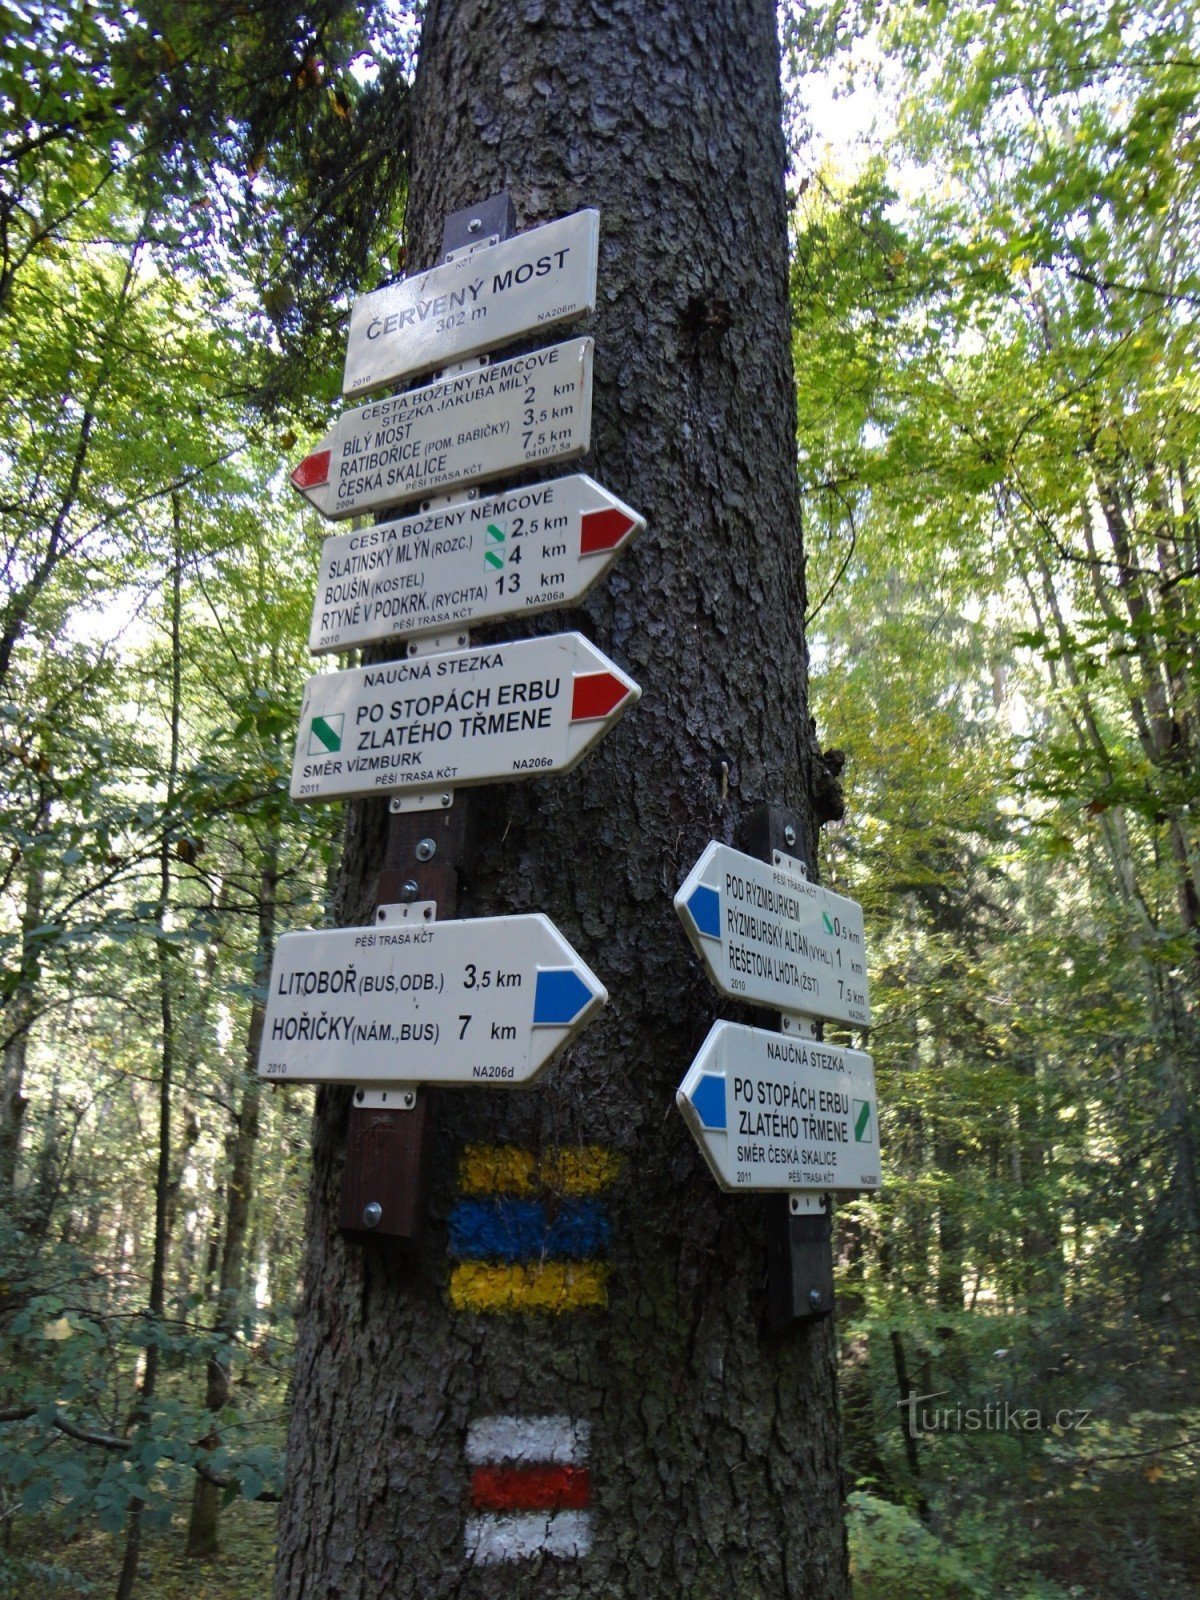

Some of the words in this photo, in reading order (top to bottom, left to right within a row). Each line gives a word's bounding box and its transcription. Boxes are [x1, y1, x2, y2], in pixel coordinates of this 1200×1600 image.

[366, 278, 484, 340] ČERVENÝ
[492, 248, 571, 293] MOST
[435, 311, 467, 334] 302
[471, 307, 488, 321] m
[537, 303, 577, 322] NA206m
[352, 375, 371, 388] 2010
[362, 397, 408, 420] CESTA
[412, 377, 472, 408] BOŽENY
[478, 349, 560, 384] NĚMCOVÉ
[342, 431, 371, 457] BÍLÝ
[375, 423, 414, 448] MOST
[523, 386, 536, 405] 2
[553, 382, 576, 397] km
[381, 405, 434, 428] STEZKA
[436, 386, 495, 413] JAKUBA
[340, 440, 422, 478] RATIBOŘICE
[457, 420, 510, 445] BABIČKY)
[522, 408, 548, 427] 3,5
[551, 405, 574, 420] km
[337, 471, 383, 499] ČESKÁ
[386, 455, 448, 488] SKALICE
[521, 430, 545, 450] 7,5
[550, 427, 572, 443] km
[405, 479, 427, 492] PĚŠÍ
[428, 470, 461, 487] TRASA
[463, 463, 484, 478] KČT
[336, 499, 355, 510] 2004
[349, 528, 397, 551] CESTA
[402, 512, 466, 538] BOŽENY
[470, 489, 554, 522] NĚMCOVÉ
[511, 517, 539, 540] 2,5
[544, 514, 568, 530] km
[508, 544, 522, 565] 4
[541, 544, 567, 559] km
[320, 603, 360, 631] RTYNĚ
[363, 602, 373, 622] V
[495, 573, 521, 596] 13
[540, 571, 565, 588] km
[525, 591, 565, 605] NA206a
[393, 617, 415, 631] PĚŠÍ
[416, 611, 451, 628] TRASA
[452, 607, 474, 622] KČT
[319, 634, 340, 646] 2010
[363, 661, 432, 688] NAUČNÁ
[437, 653, 504, 677] STEZKA
[355, 702, 384, 726] PO
[389, 687, 491, 721] STOPÁCH
[497, 678, 560, 706] ERBU
[357, 719, 453, 751] ZLATÉHO
[460, 707, 552, 738] TŘMENE
[303, 758, 342, 778] SMĚR
[347, 750, 423, 773] VÍZMBURK
[375, 771, 398, 786] PĚŠÍ
[400, 769, 434, 784] TRASA
[436, 766, 458, 780] KČT
[512, 757, 553, 770] NA206e
[300, 784, 320, 795] 2011
[787, 878, 806, 894] TRASA
[726, 873, 744, 901] POD
[746, 878, 800, 921] RÝZMBURKEM
[833, 916, 848, 940] 0,5
[848, 930, 861, 945] km
[355, 934, 376, 948] PĚŠÍ
[378, 933, 411, 946] TRASA
[413, 931, 435, 944] KČT
[727, 905, 783, 949] RÝZMBURSKÝ
[836, 947, 842, 968] 1
[851, 957, 863, 975] km
[463, 963, 491, 991] 3,5
[496, 970, 522, 988] km
[728, 940, 774, 982] ŘEŠETOVA
[837, 979, 852, 1003] 7,5
[853, 990, 865, 1006] km
[731, 978, 746, 991] 2010
[458, 1014, 472, 1041] 7
[491, 1021, 517, 1041] km
[267, 1062, 287, 1075] 2010
[767, 1042, 808, 1066] NAUČNÁ
[810, 1051, 845, 1073] STEZKA
[472, 1065, 515, 1079] NA206d
[734, 1077, 753, 1103] PO
[757, 1081, 816, 1111] STOPÁCH
[819, 1091, 849, 1115] ERBU
[739, 1109, 799, 1139] ZLATÉHO
[802, 1113, 848, 1143] TŘMENE
[737, 1143, 765, 1163] SMĚR
[768, 1144, 799, 1164] ČESKÁ
[801, 1151, 837, 1166] SKALICE
[737, 1171, 752, 1183] 2011
[788, 1170, 802, 1183] PĚŠÍ
[803, 1172, 823, 1183] TRASA
